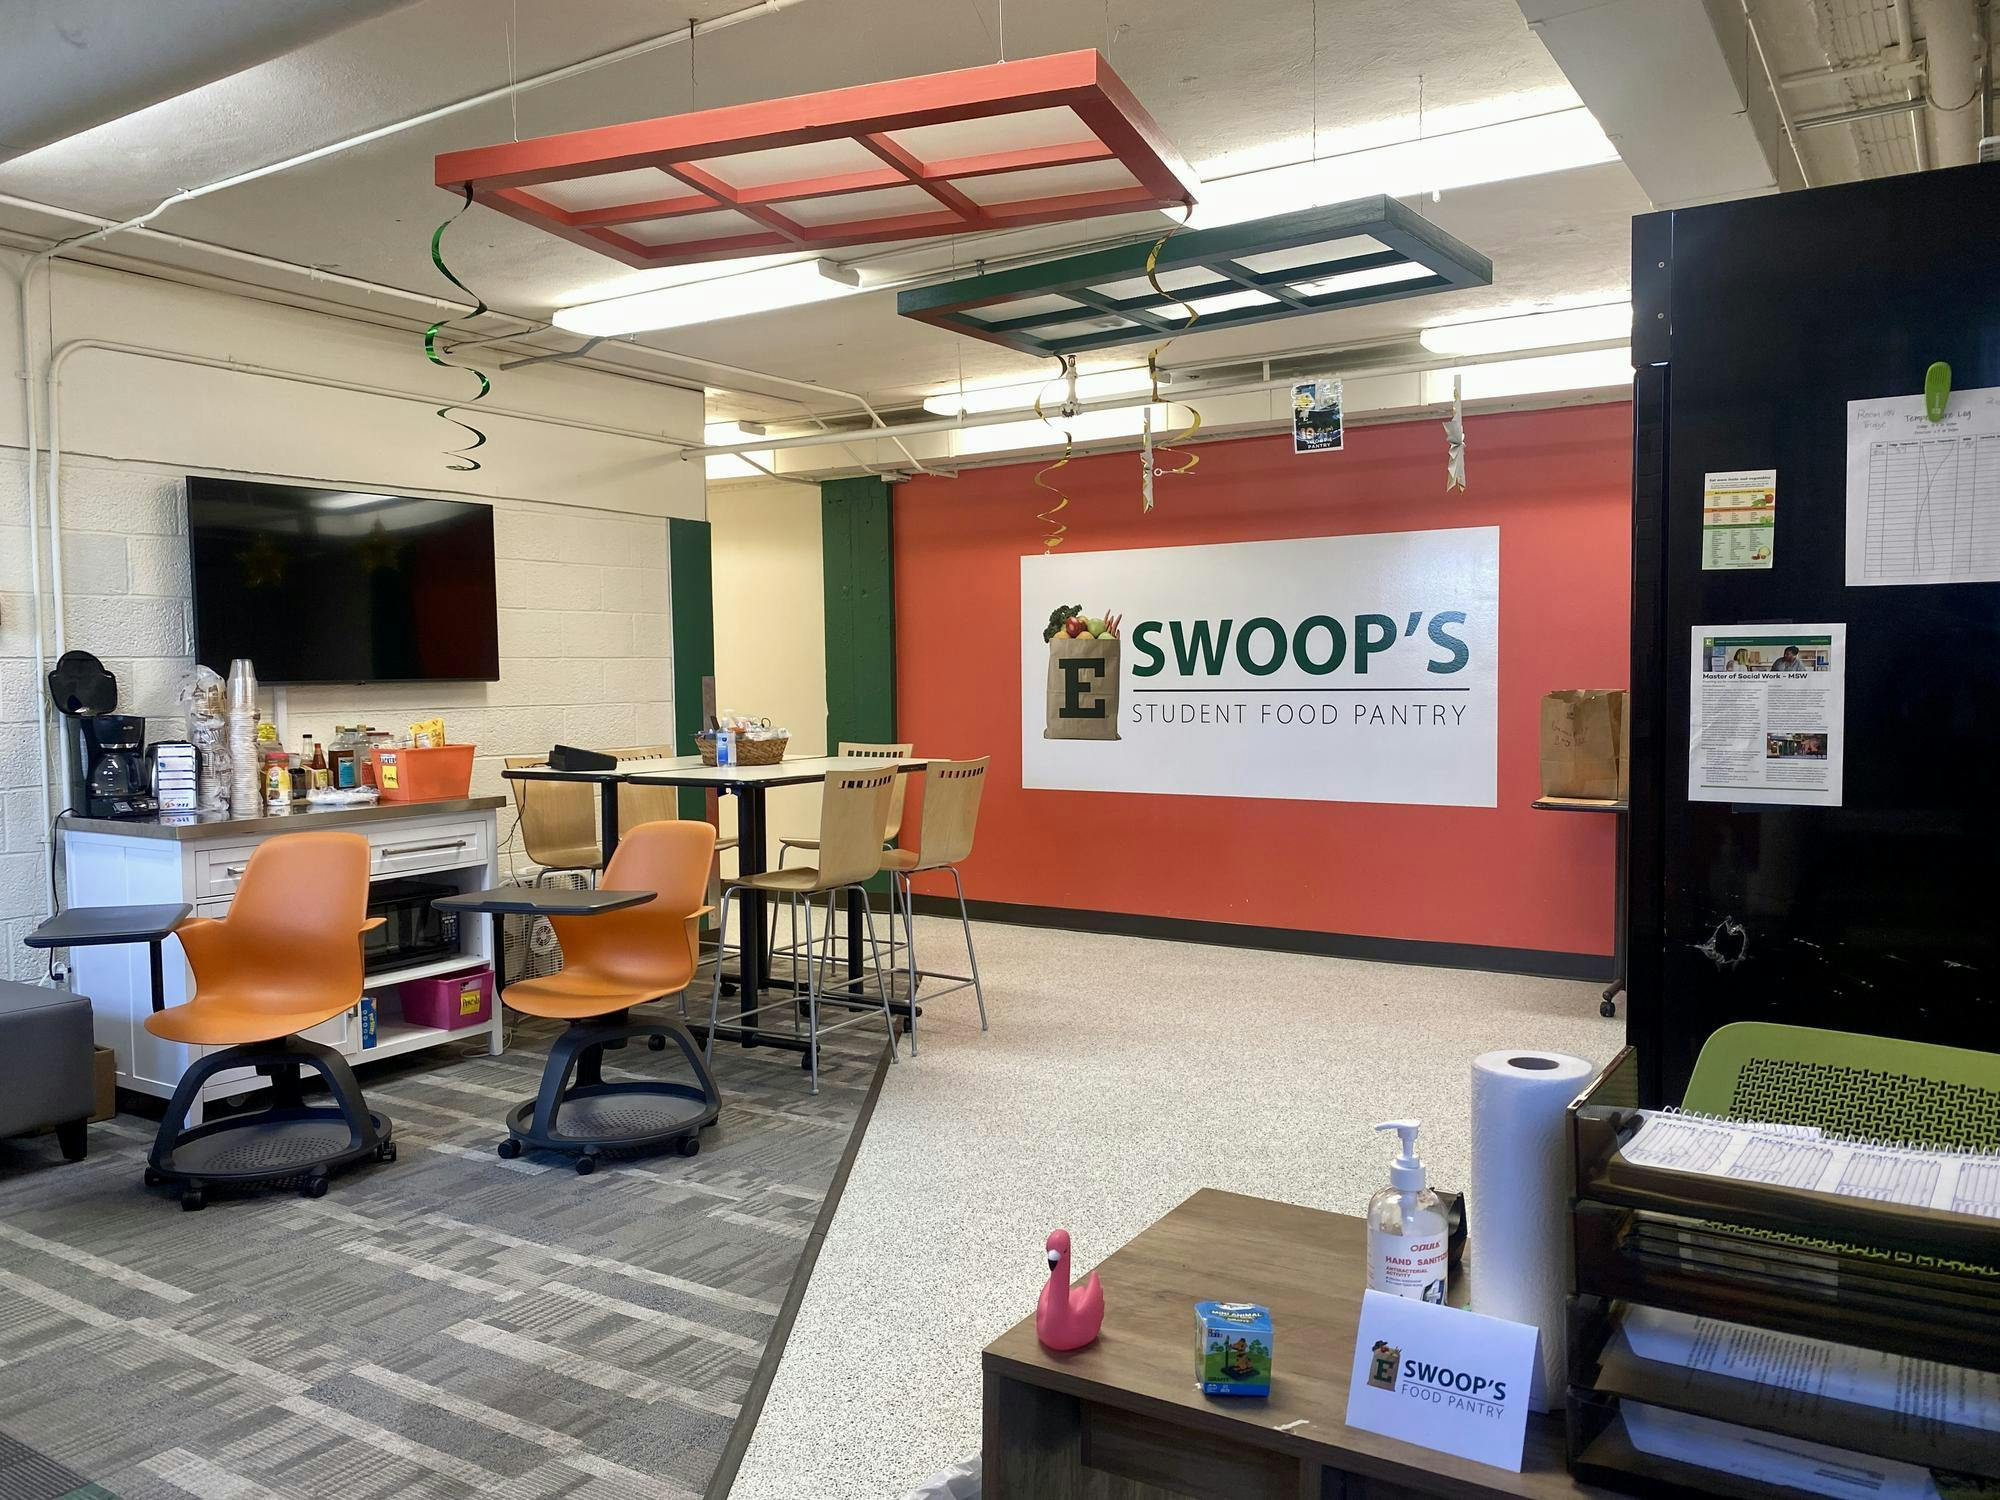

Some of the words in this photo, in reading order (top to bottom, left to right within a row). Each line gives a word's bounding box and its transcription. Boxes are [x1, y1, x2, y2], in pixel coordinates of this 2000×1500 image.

[1957, 410, 1972, 421] Log
[1132, 610, 1470, 677] SWOOP'S
[1728, 672, 1737, 680] of
[1059, 658, 1106, 719] E
[1132, 703, 1247, 725] STUDENT
[1261, 703, 1338, 725] FOOD
[1354, 703, 1467, 726] PANTRY
[1385, 1256, 1412, 1266] HAND
[1385, 1266, 1428, 1274] ANTIBACTERIAL
[1373, 1358, 1395, 1384] E
[1403, 1360, 1507, 1401] SWOOP'S
[1401, 1384, 1442, 1404] FOOD
[1447, 1395, 1504, 1420] PANTRY
